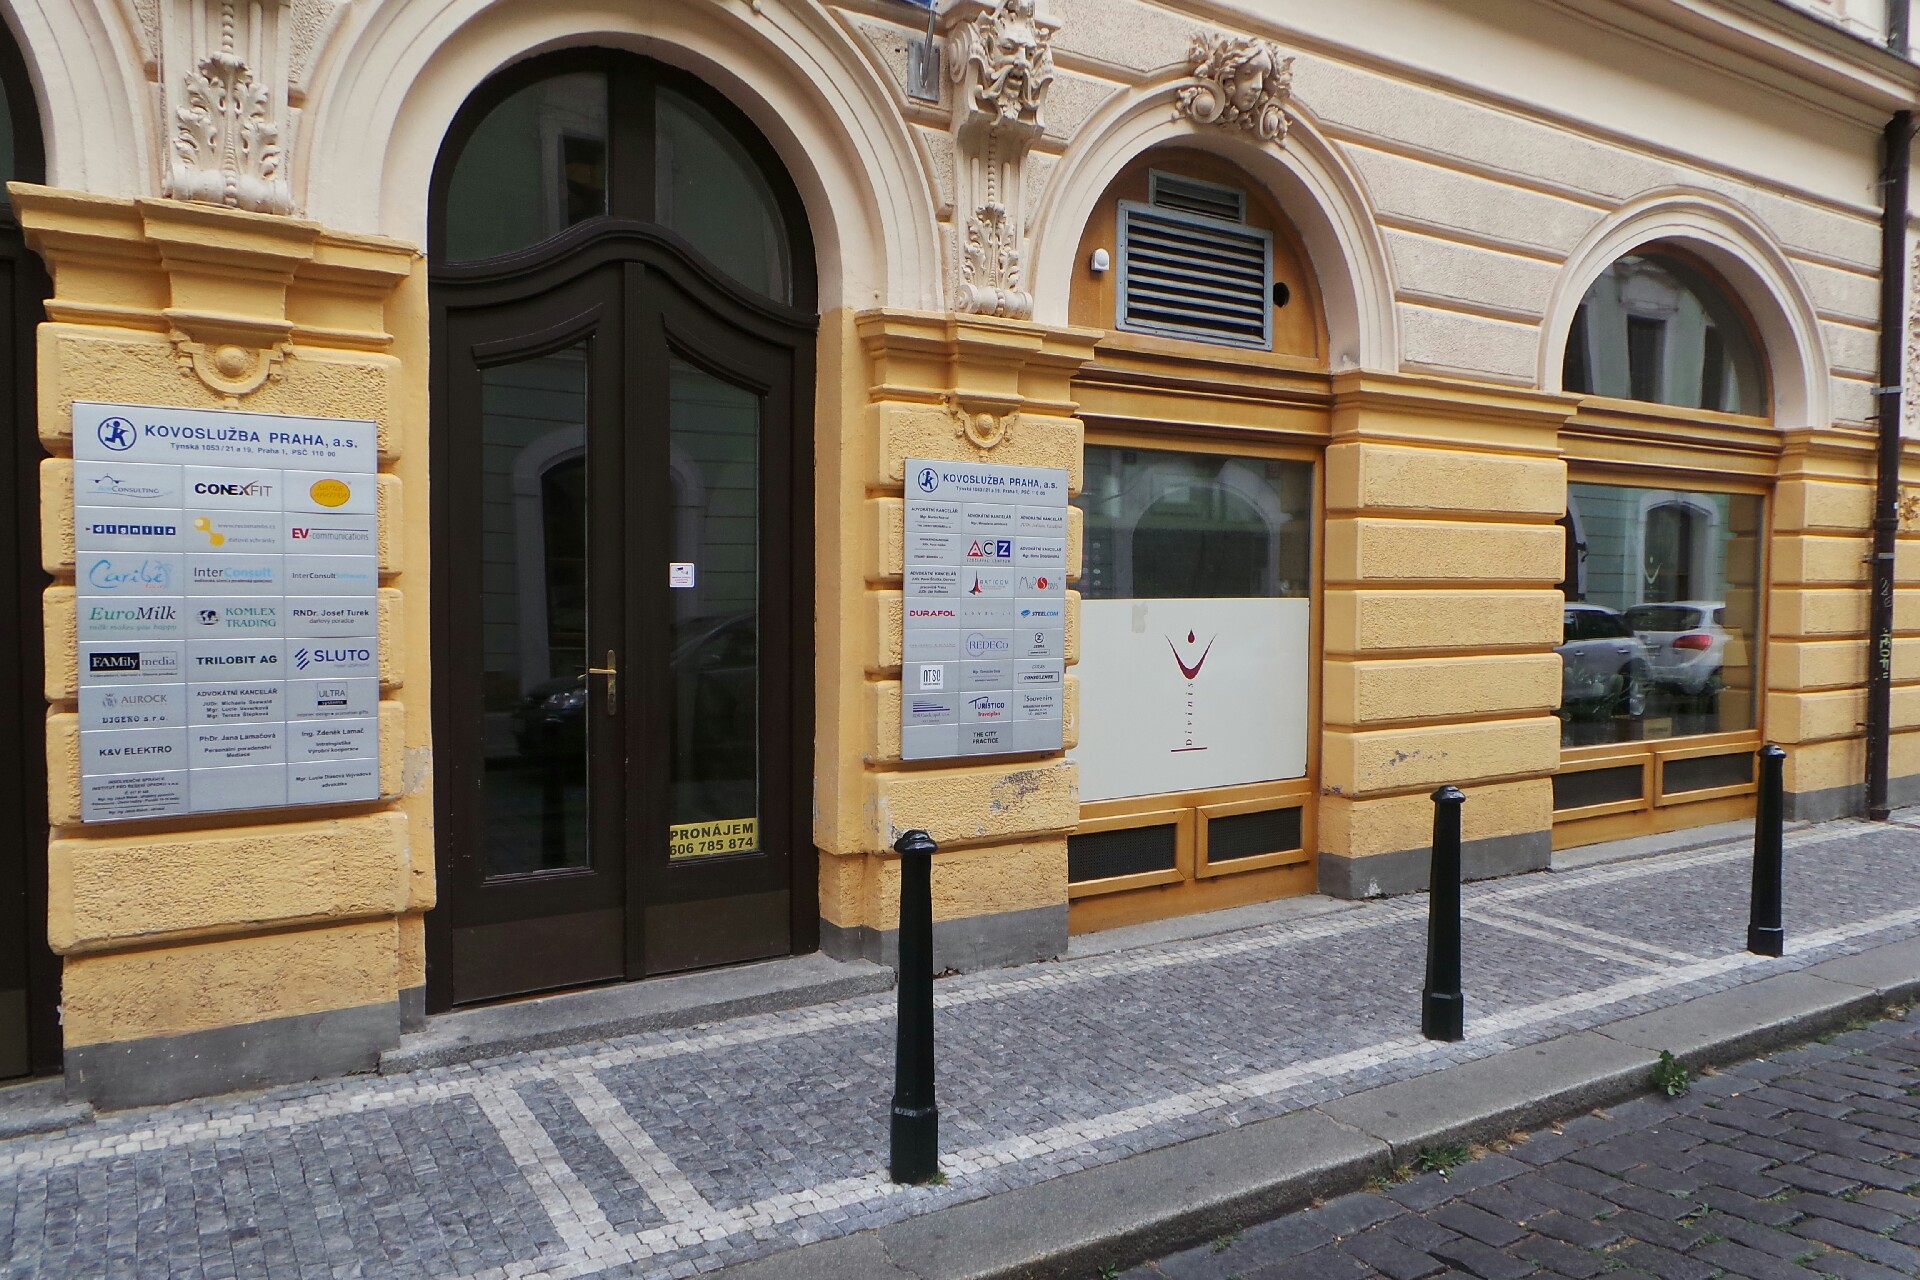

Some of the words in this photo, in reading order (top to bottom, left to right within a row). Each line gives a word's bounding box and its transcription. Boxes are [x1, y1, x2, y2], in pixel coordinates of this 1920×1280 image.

[145, 424, 260, 443] KOVOSLUŽBA
[269, 432, 330, 448] PRAHA,
[333, 437, 358, 449] a.s.
[257, 447, 279, 455] Praha
[292, 448, 308, 456] PSČ
[943, 473, 1005, 485] KOVOSLUŽBA
[1009, 477, 1042, 489] PRAHA,
[1043, 481, 1058, 489] a.s.
[194, 480, 273, 496] CONEXFIT
[93, 525, 176, 535] dignita
[194, 567, 272, 578] InterConsult
[89, 606, 177, 621] EuroMilk
[225, 607, 276, 616] KOMLEX
[293, 609, 318, 617] RNDr.
[321, 609, 344, 617] Josef
[225, 618, 277, 627] TRADING
[195, 655, 256, 666] TRILOBIT
[259, 655, 278, 664] AG
[314, 649, 370, 662] SLUTO
[92, 656, 138, 669] FAMily
[141, 655, 176, 667] media
[196, 688, 238, 697] ADVOKÁTNÍ
[239, 687, 278, 696] KANCELÁŘ
[318, 688, 346, 698] ULTRA
[121, 694, 168, 704] AUROCK
[1185, 682, 1194, 746] Divinis
[239, 732, 276, 741] Lamačová
[342, 727, 364, 735] Lamač
[99, 748, 122, 757] K&V
[124, 745, 173, 756] ELEKTRO
[670, 822, 753, 841] PRONÁJEM
[670, 843, 694, 856] 606
[698, 839, 724, 853] 785
[728, 836, 753, 850] 874
